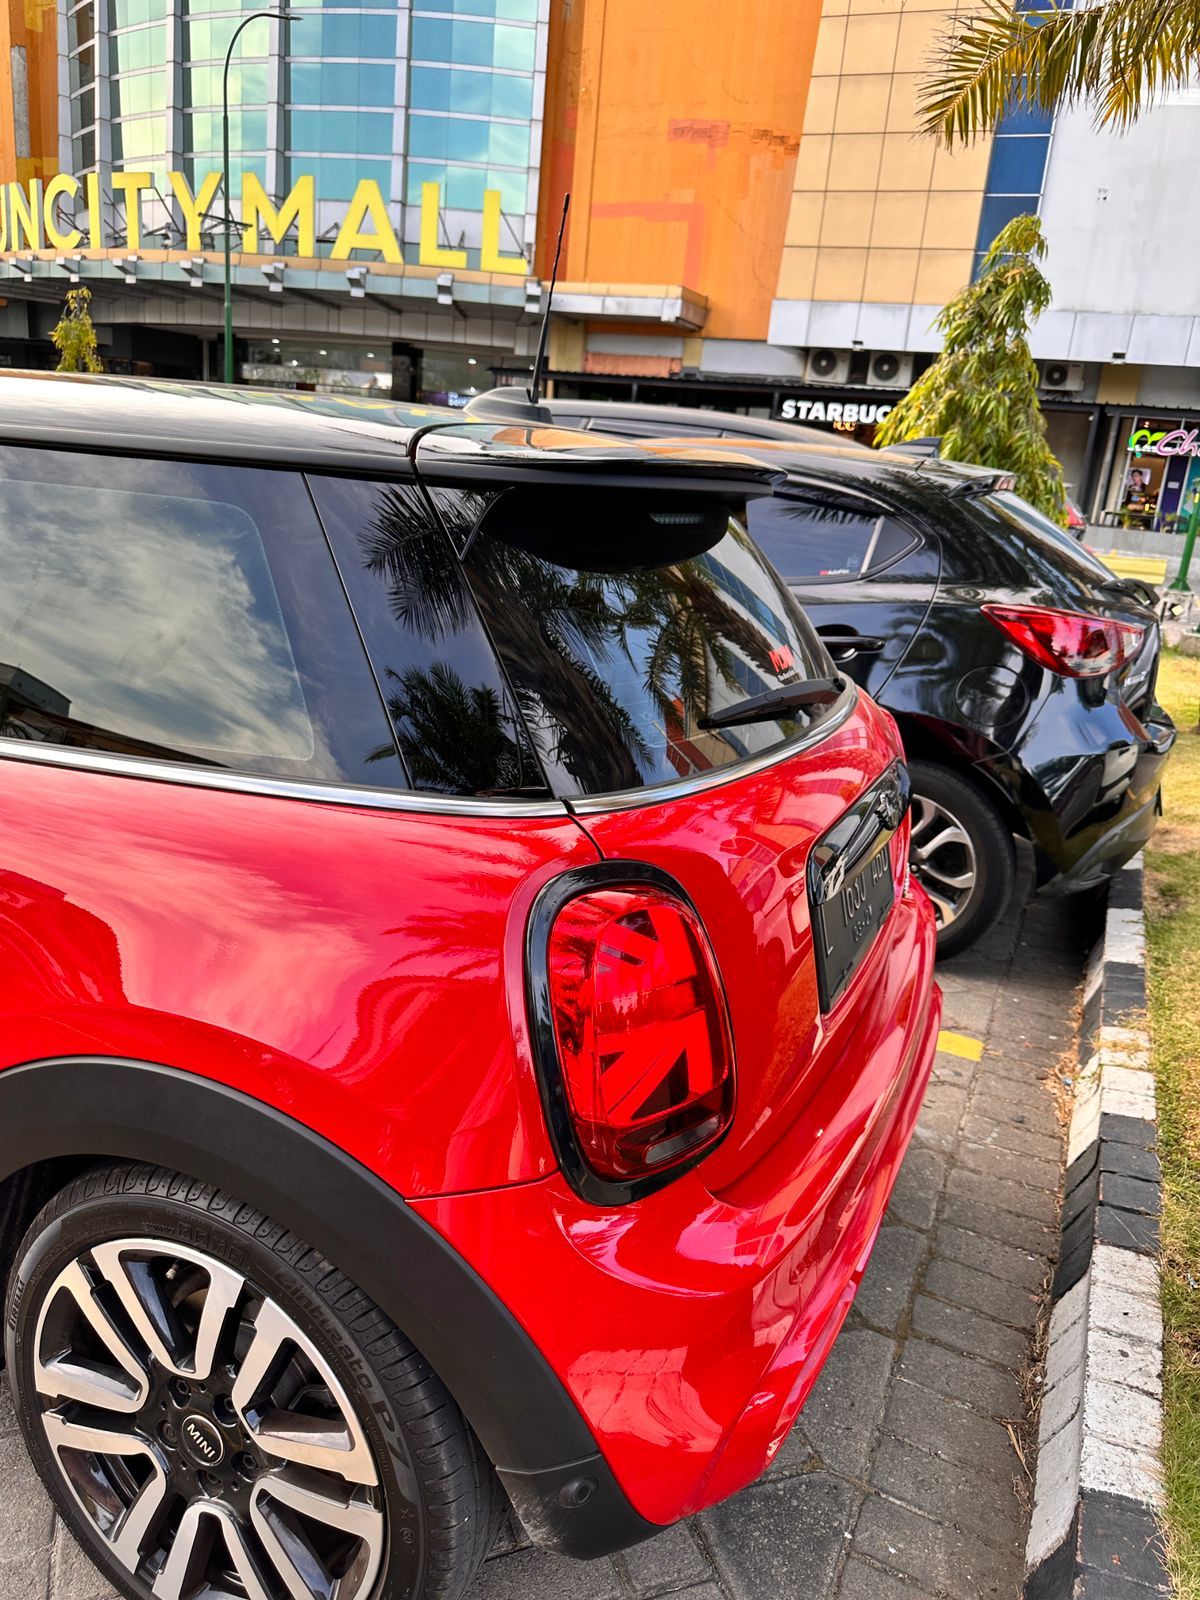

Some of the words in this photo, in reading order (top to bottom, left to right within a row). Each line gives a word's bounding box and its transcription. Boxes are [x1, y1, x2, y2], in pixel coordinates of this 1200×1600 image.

[0, 172, 223, 253] NCITY
[242, 172, 528, 275] MALL
[781, 399, 895, 424] STARBUC
[1156, 429, 1200, 457] Ch
[187, 1423, 216, 1458] MINI
[371, 1400, 411, 1469] P7
